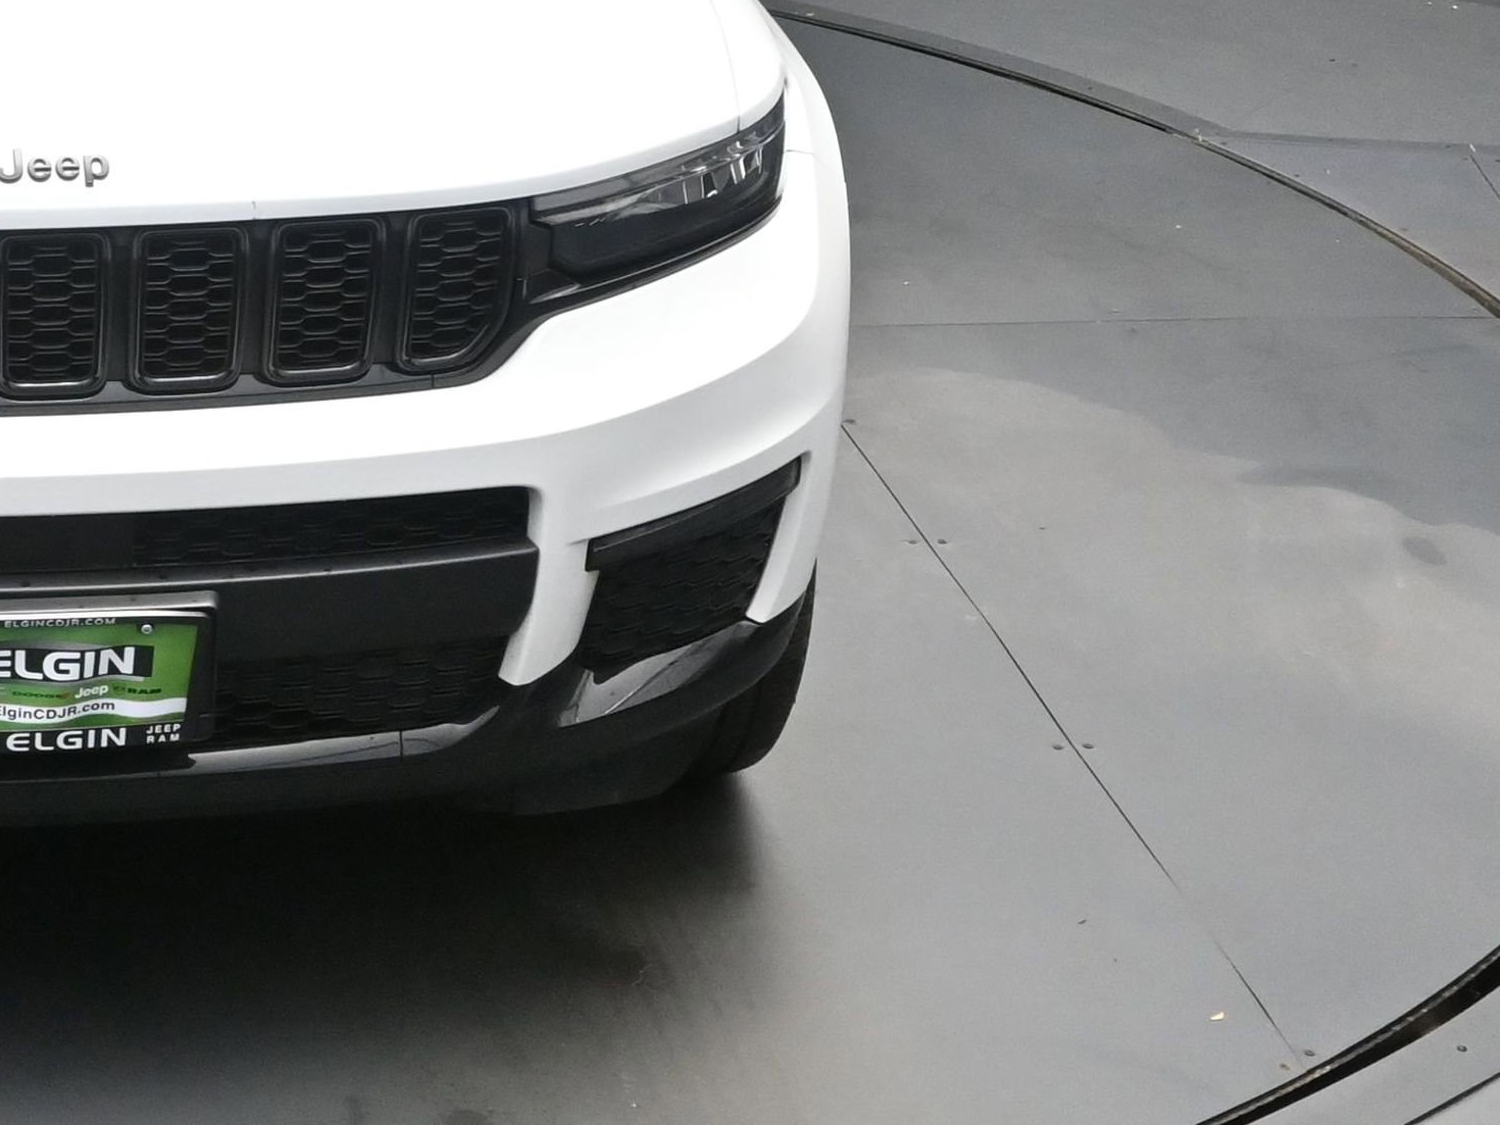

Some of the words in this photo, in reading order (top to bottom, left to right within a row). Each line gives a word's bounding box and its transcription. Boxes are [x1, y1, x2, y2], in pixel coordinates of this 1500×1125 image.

[4, 618, 116, 628] ELGINCDJR.COM
[75, 685, 109, 699] Jeep
[146, 724, 181, 734] JEEP
[6, 728, 126, 752] ELGIN
[147, 733, 180, 743] RAM
